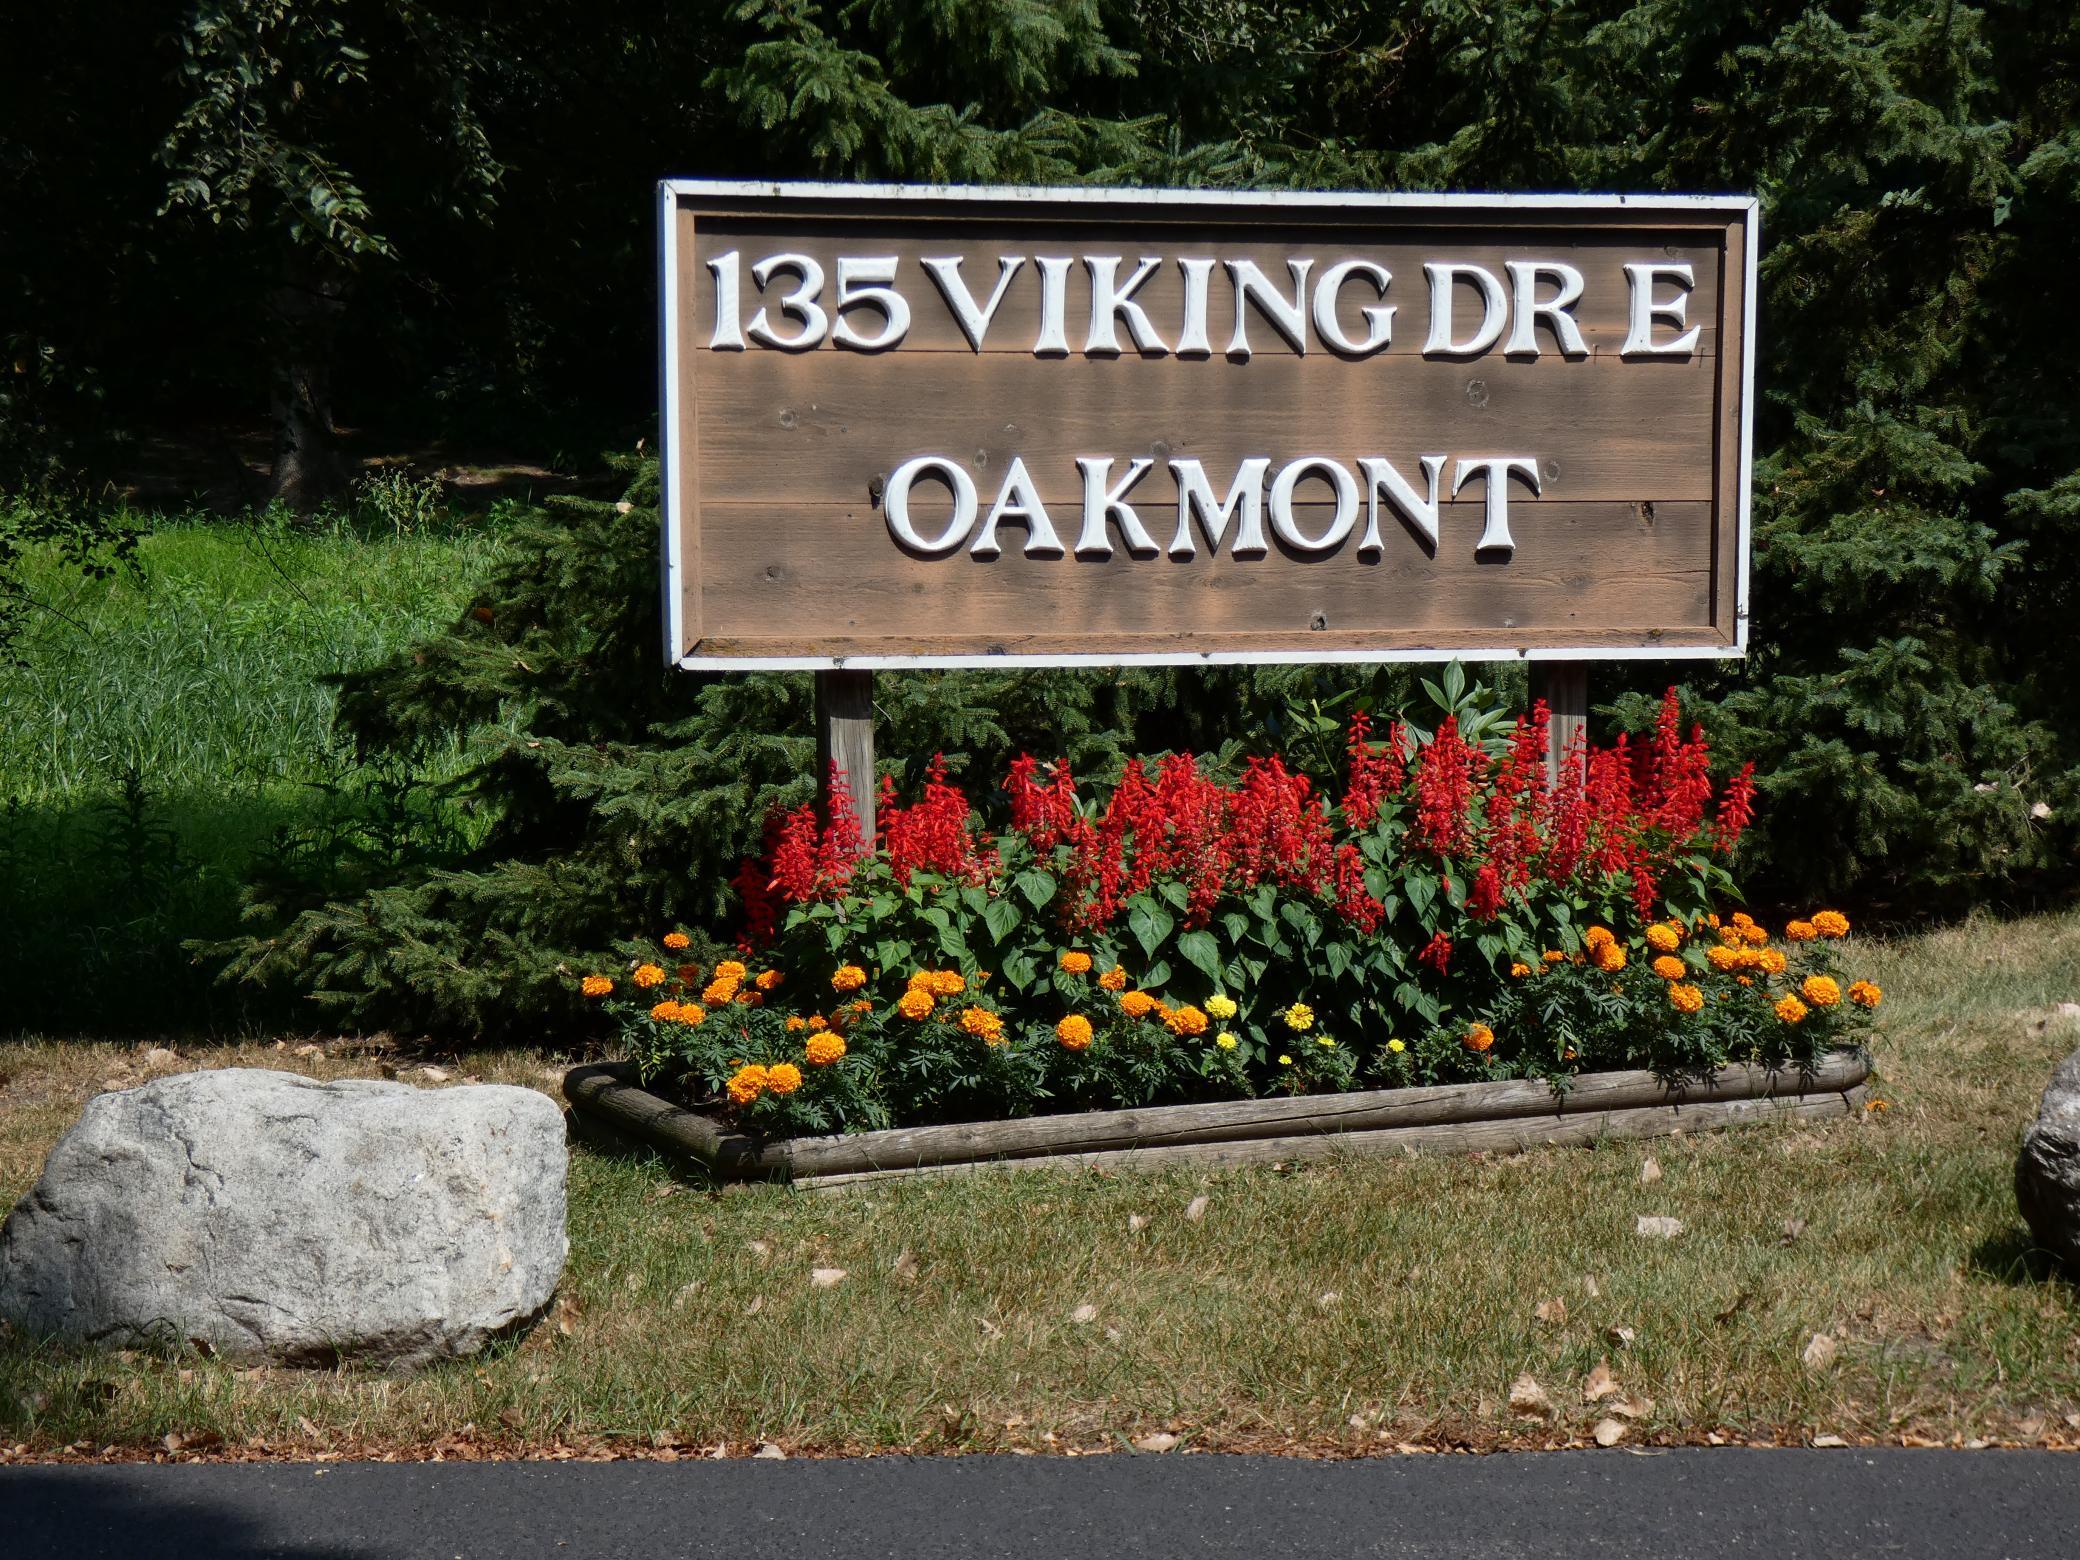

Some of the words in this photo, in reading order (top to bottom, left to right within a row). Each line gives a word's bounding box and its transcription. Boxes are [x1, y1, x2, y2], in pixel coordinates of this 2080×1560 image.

[706, 250, 912, 349] 135
[919, 255, 1399, 357] VIKING
[1421, 261, 1592, 357] DR
[1619, 262, 1702, 357] E
[884, 455, 1541, 554] OAKMONT
